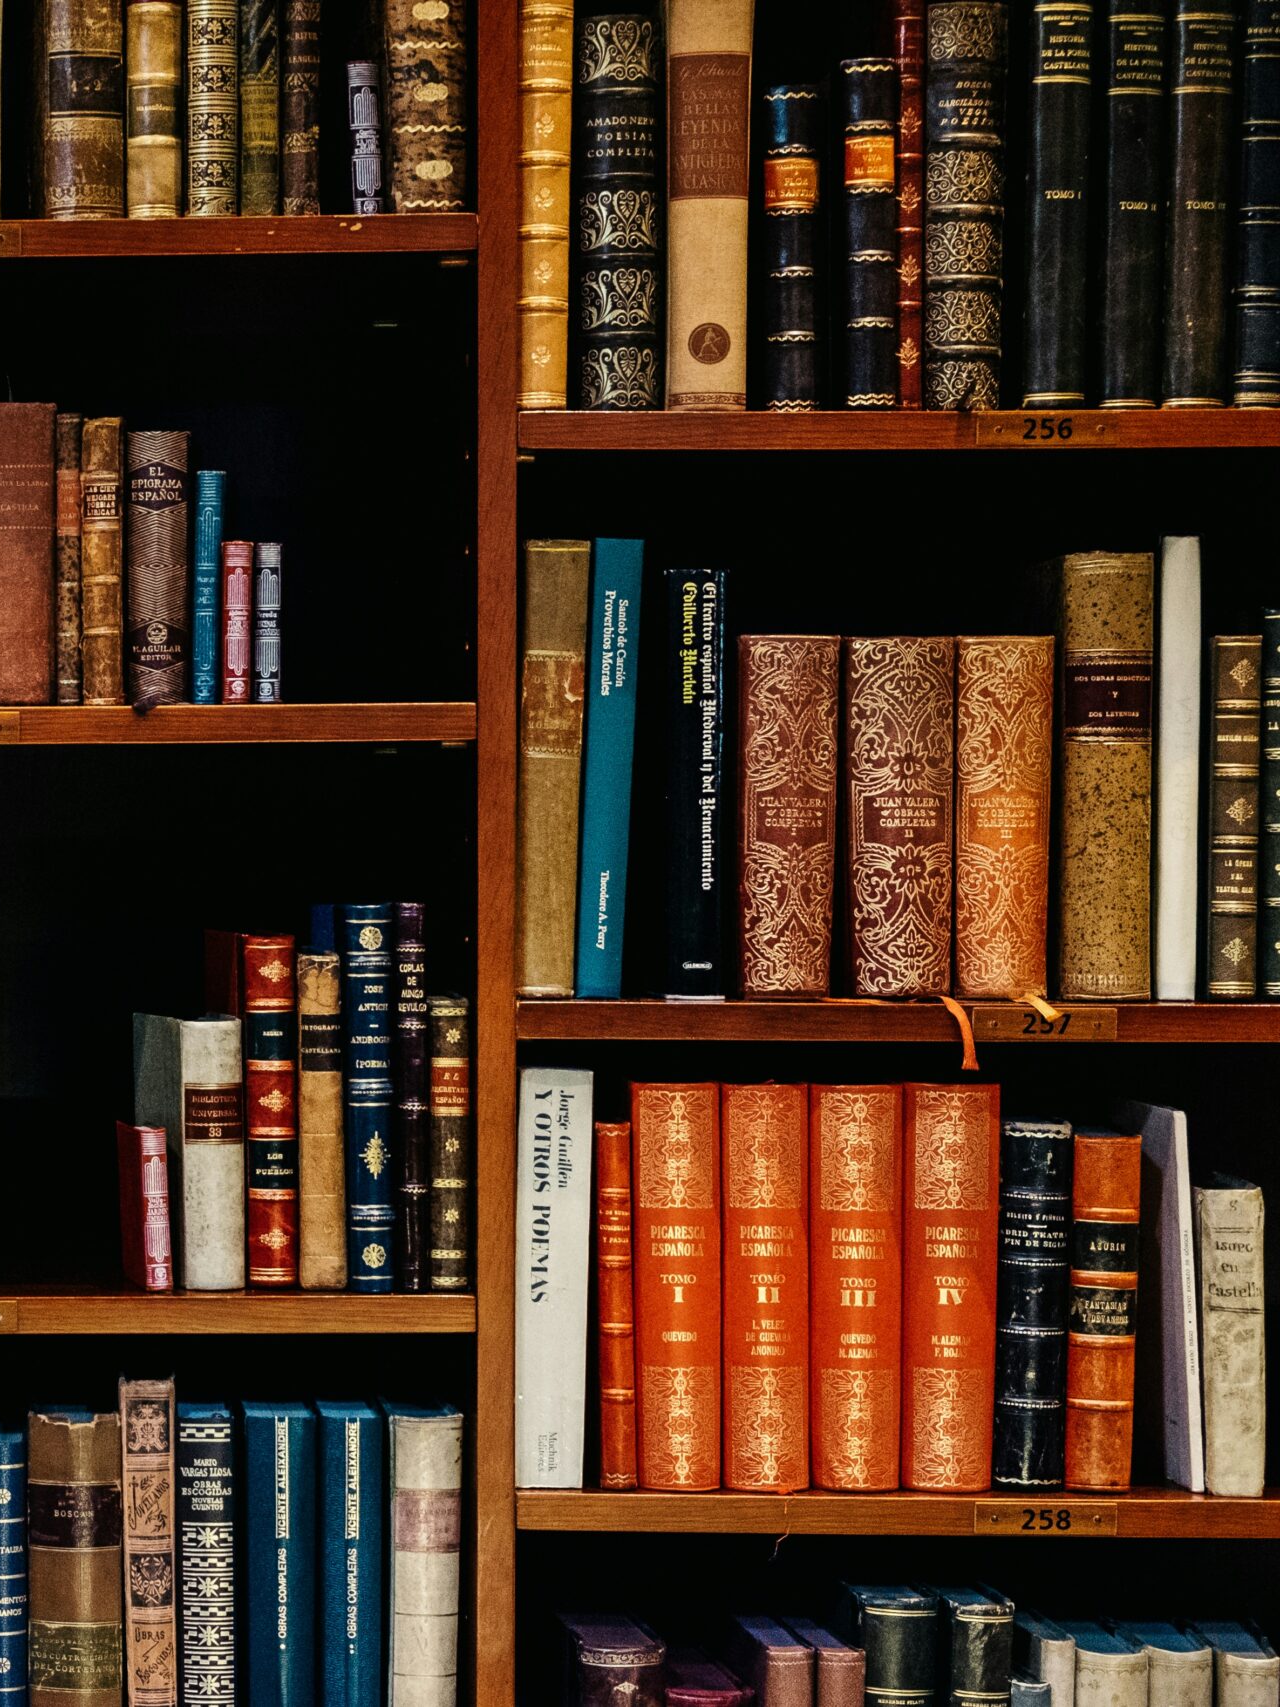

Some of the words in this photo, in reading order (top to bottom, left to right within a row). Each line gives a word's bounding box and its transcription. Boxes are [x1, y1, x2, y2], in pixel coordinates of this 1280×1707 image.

[586, 115, 629, 128] AMADO
[1044, 190, 1075, 200] TOMO
[1119, 200, 1148, 210] TOMO
[1185, 200, 1216, 210] TOMO
[1022, 417, 1073, 440] 256
[148, 466, 165, 477] EL
[131, 479, 183, 490] EPIGRAMA
[131, 489, 182, 502] ESPAÑOL
[702, 581, 717, 599] El
[602, 590, 617, 650] Proverbios
[617, 599, 629, 635] Santob
[682, 581, 698, 646] Edilberto
[702, 602, 716, 641] teatro
[616, 635, 628, 648] de
[601, 651, 614, 697] Morales
[615, 649, 627, 688] Carrión
[679, 648, 698, 705] Marbán
[699, 644, 716, 695] español
[699, 699, 716, 760] Medieval
[872, 796, 904, 807] JUAN
[904, 796, 941, 807] VALERA
[779, 808, 814, 818] OBRAS
[893, 808, 927, 817] OBRAS
[764, 817, 823, 828] COMPLETAS
[879, 817, 937, 828] COMPLETAS
[599, 870, 611, 912] Theodore
[598, 911, 609, 925] A.
[595, 924, 608, 951] Perry
[399, 963, 425, 973] COPLAS
[406, 976, 418, 986] DE
[401, 989, 424, 999] MINGO
[1022, 1012, 1072, 1035] 257
[534, 1089, 553, 1106] Y
[556, 1089, 575, 1131] Jorge
[533, 1112, 553, 1193] OTROS
[556, 1135, 575, 1189] Guillén
[650, 1225, 706, 1240] PICARESCA
[740, 1225, 795, 1240] PICARESCA
[830, 1227, 887, 1242] PICARESCA
[924, 1226, 980, 1241] PICARESCA
[530, 1203, 551, 1304] POEMAS
[651, 1242, 705, 1257] ESPAÑOLA
[740, 1241, 794, 1257] ESPAÑOLA
[831, 1244, 885, 1260] ESPAÑOLA
[925, 1243, 979, 1259] ESPAÑOLA
[659, 1273, 697, 1285] TOMO
[749, 1273, 786, 1285] TOMO
[839, 1277, 878, 1288] TOMO
[933, 1275, 970, 1287] TOMO
[672, 1286, 685, 1304] I
[755, 1286, 781, 1304] II
[839, 1289, 878, 1308] III
[937, 1287, 968, 1306] IV
[662, 1331, 697, 1344] QUEVEDO
[840, 1333, 877, 1345] QUEVEDO
[192, 1458, 218, 1467] MARIO
[277, 1421, 288, 1490] ALEIXANDRE
[347, 1421, 358, 1490] ALEIXANDRE
[179, 1466, 208, 1477] VARGAS
[180, 1486, 233, 1496] ESCOGIDAS
[192, 1480, 222, 1489] OBRAS
[277, 1491, 288, 1538] VICENTE
[347, 1491, 358, 1538] VICENTE
[1021, 1508, 1071, 1531] 258
[277, 1547, 288, 1604] COMPLETAS
[347, 1547, 358, 1604] COMPLETAS
[277, 1605, 288, 1639] OBRAS
[347, 1605, 358, 1639] OBRAS
